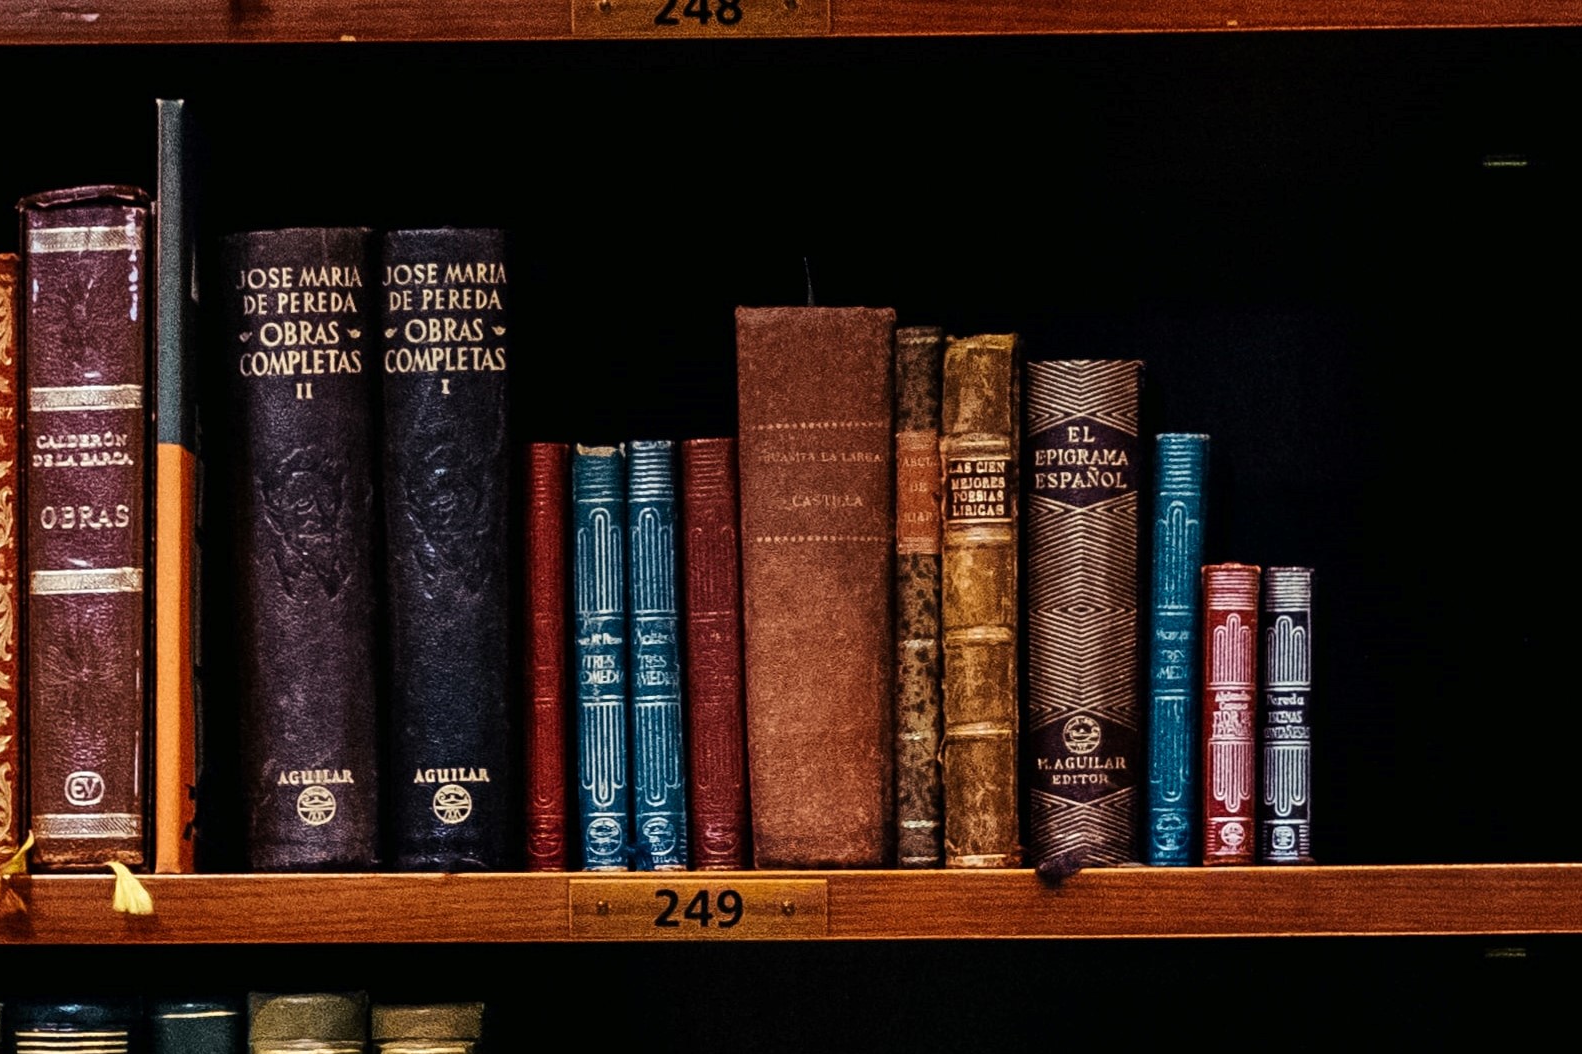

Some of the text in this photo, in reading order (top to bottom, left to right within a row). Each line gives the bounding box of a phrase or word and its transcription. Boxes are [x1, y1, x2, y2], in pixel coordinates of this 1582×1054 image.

[655, 0, 744, 26] 248
[237, 265, 362, 290] JOSE MARIA
[382, 262, 506, 287] JOSE MARIA
[244, 291, 358, 315] DE PEREDA
[389, 289, 502, 311] DE PEREDA
[260, 321, 339, 347] OBRAS
[405, 318, 483, 343] OBRAS
[240, 349, 362, 376] COMPLETAS
[384, 347, 506, 373] COMPLETAS
[296, 383, 313, 400] II
[36, 432, 128, 450] CALDERÓN
[1068, 426, 1096, 443] EL
[1034, 448, 1129, 467] EPIGRAMA
[1035, 466, 1127, 490] ESPAÑOL
[40, 504, 130, 530] OBRAS
[277, 769, 355, 786] AGUILAR
[413, 767, 491, 785] AGUILAR
[655, 888, 745, 928] 249
